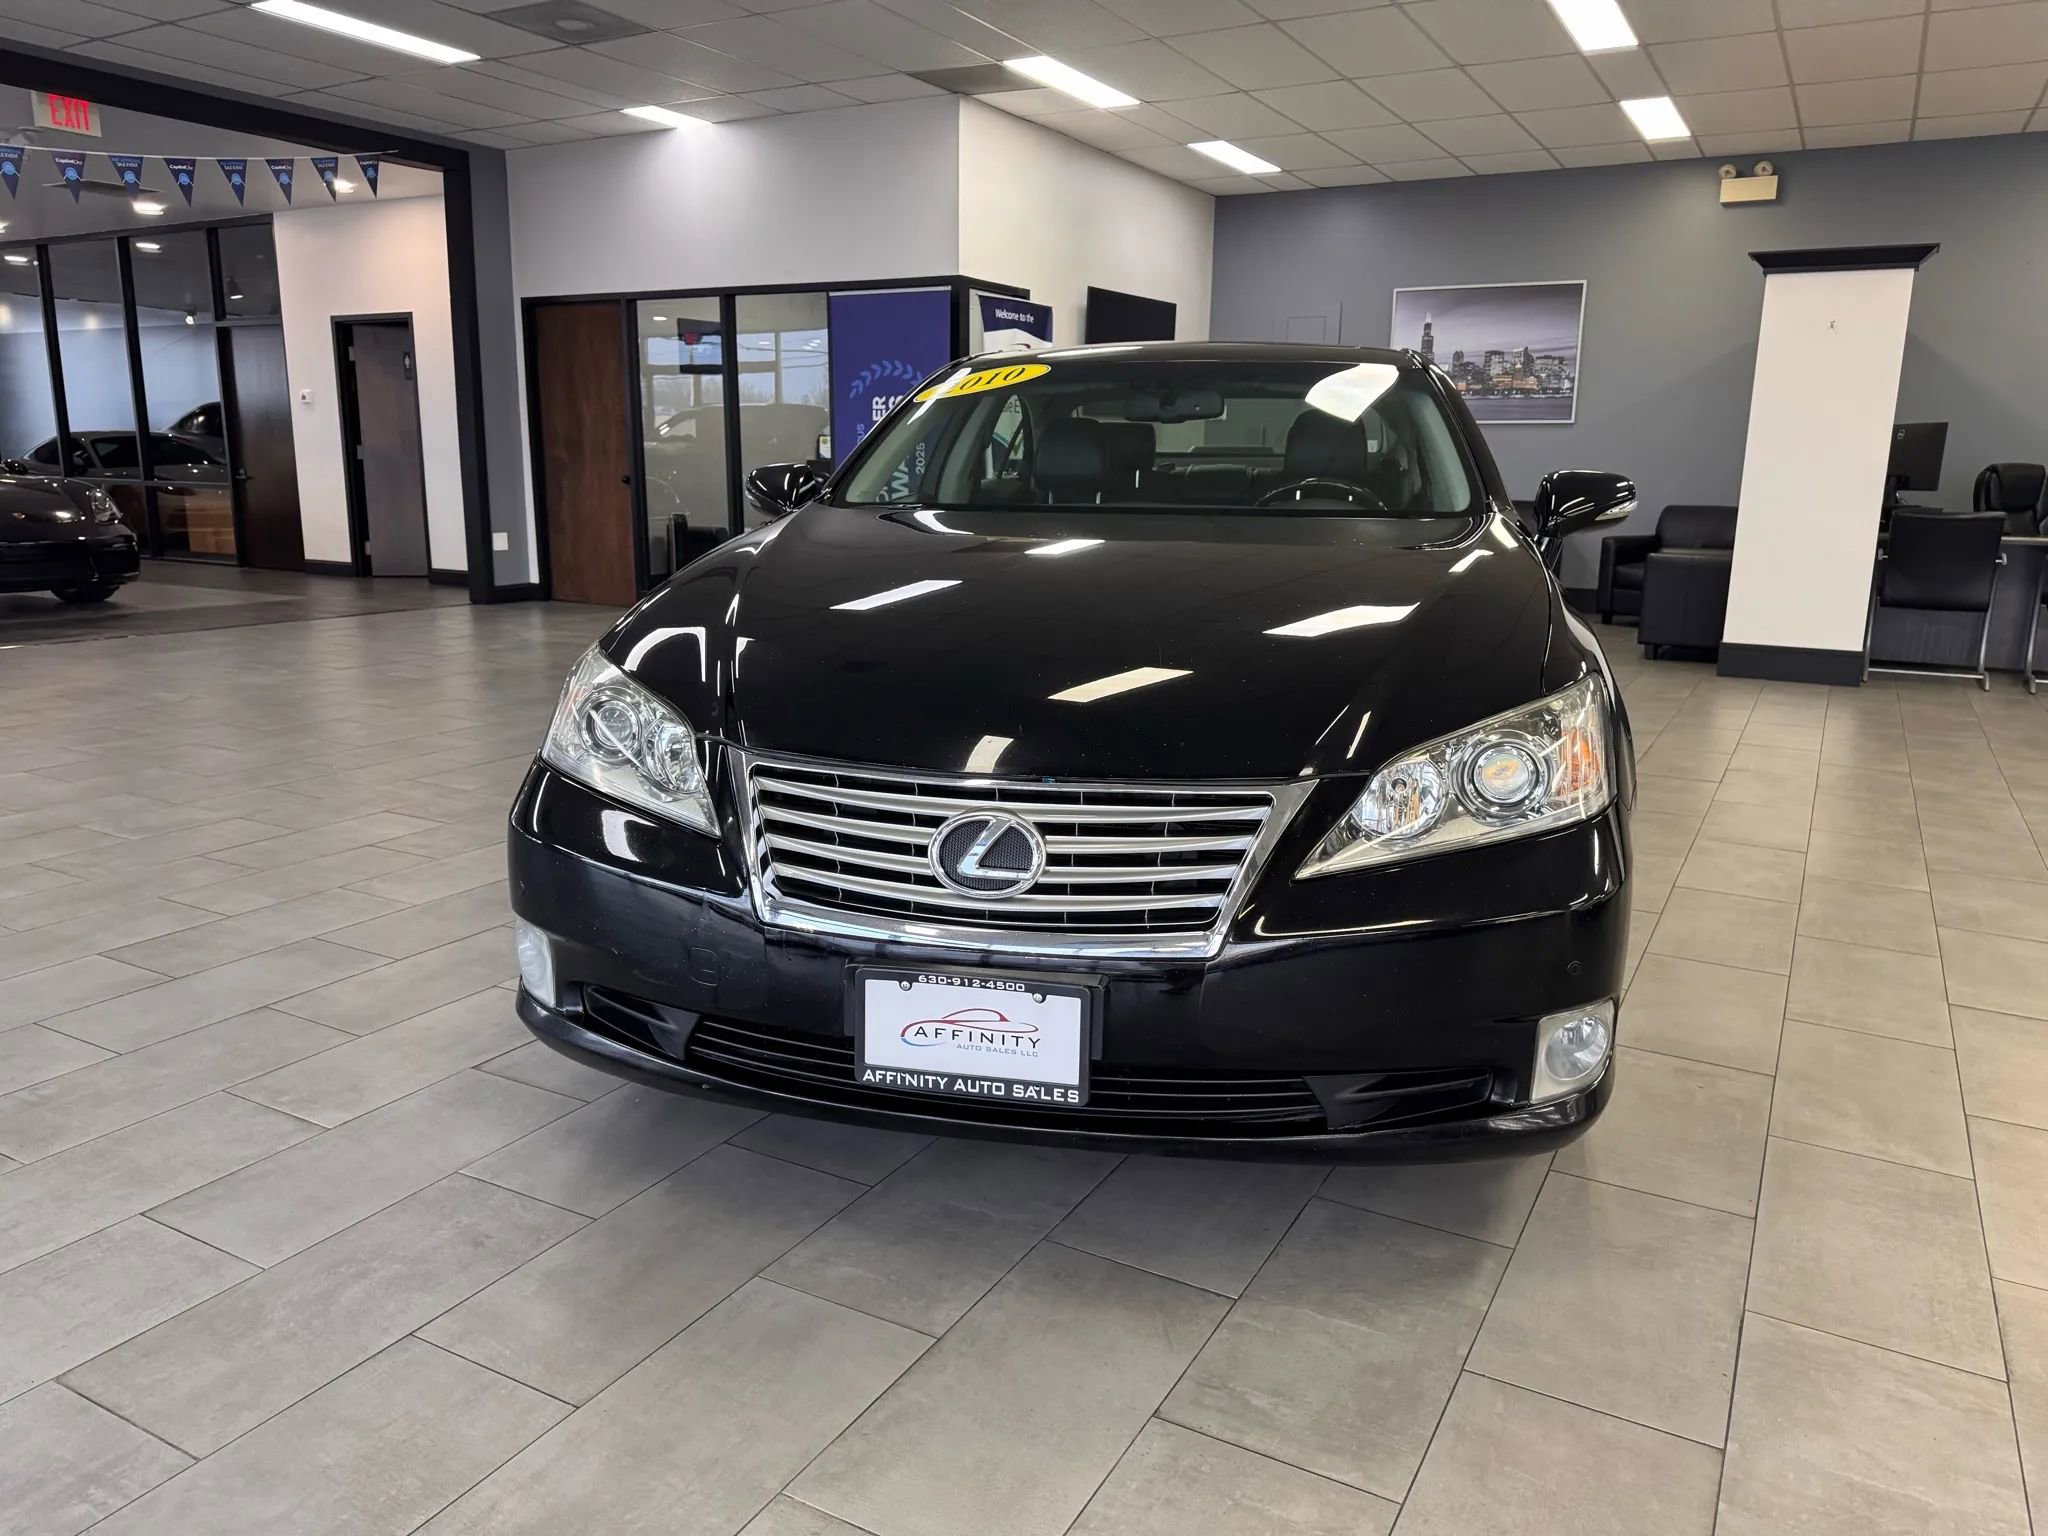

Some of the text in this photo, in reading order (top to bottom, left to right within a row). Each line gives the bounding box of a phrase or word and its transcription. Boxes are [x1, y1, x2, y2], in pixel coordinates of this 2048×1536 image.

[47, 94, 90, 131] EXIT
[995, 308, 1035, 324] Welcome to the
[916, 442, 925, 475] 2025
[918, 975, 1026, 992] 630-912-4500
[914, 1026, 1041, 1049] AFFINITY
[956, 1043, 1039, 1058] AUTO SALES LLC
[862, 1069, 1080, 1103] AFFINITY AUTO SALES
